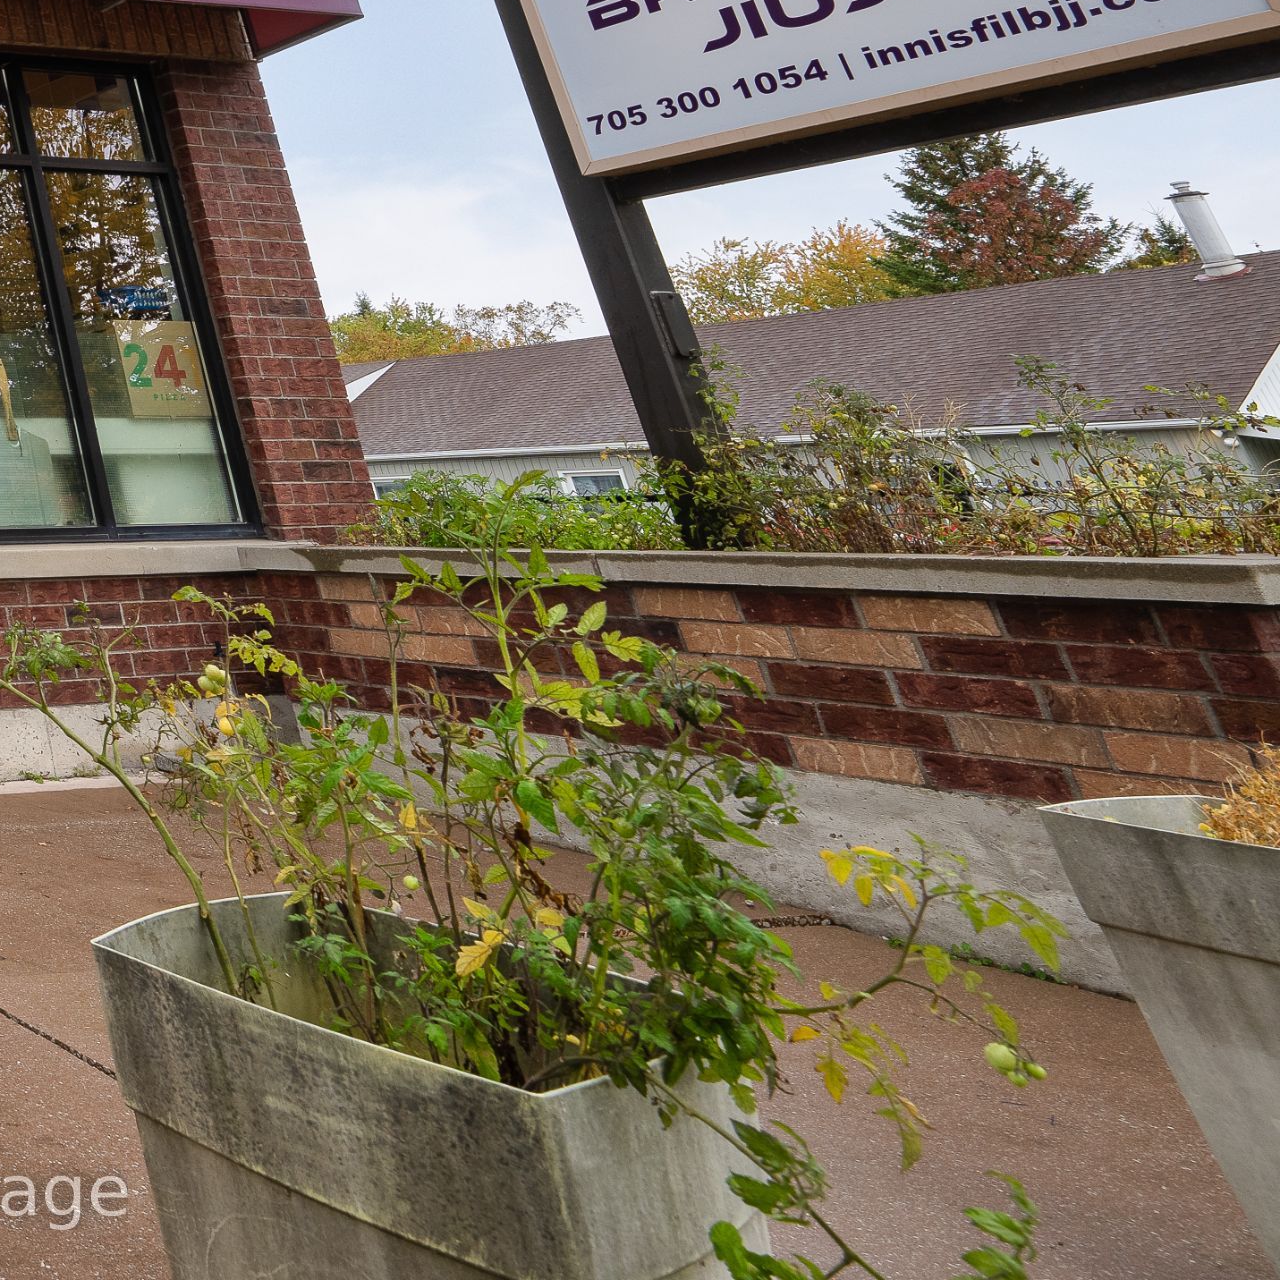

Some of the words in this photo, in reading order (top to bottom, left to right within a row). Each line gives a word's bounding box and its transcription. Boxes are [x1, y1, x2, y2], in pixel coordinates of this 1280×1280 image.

[587, 104, 648, 136] 705
[656, 85, 722, 120] 300
[732, 58, 829, 102] 1054
